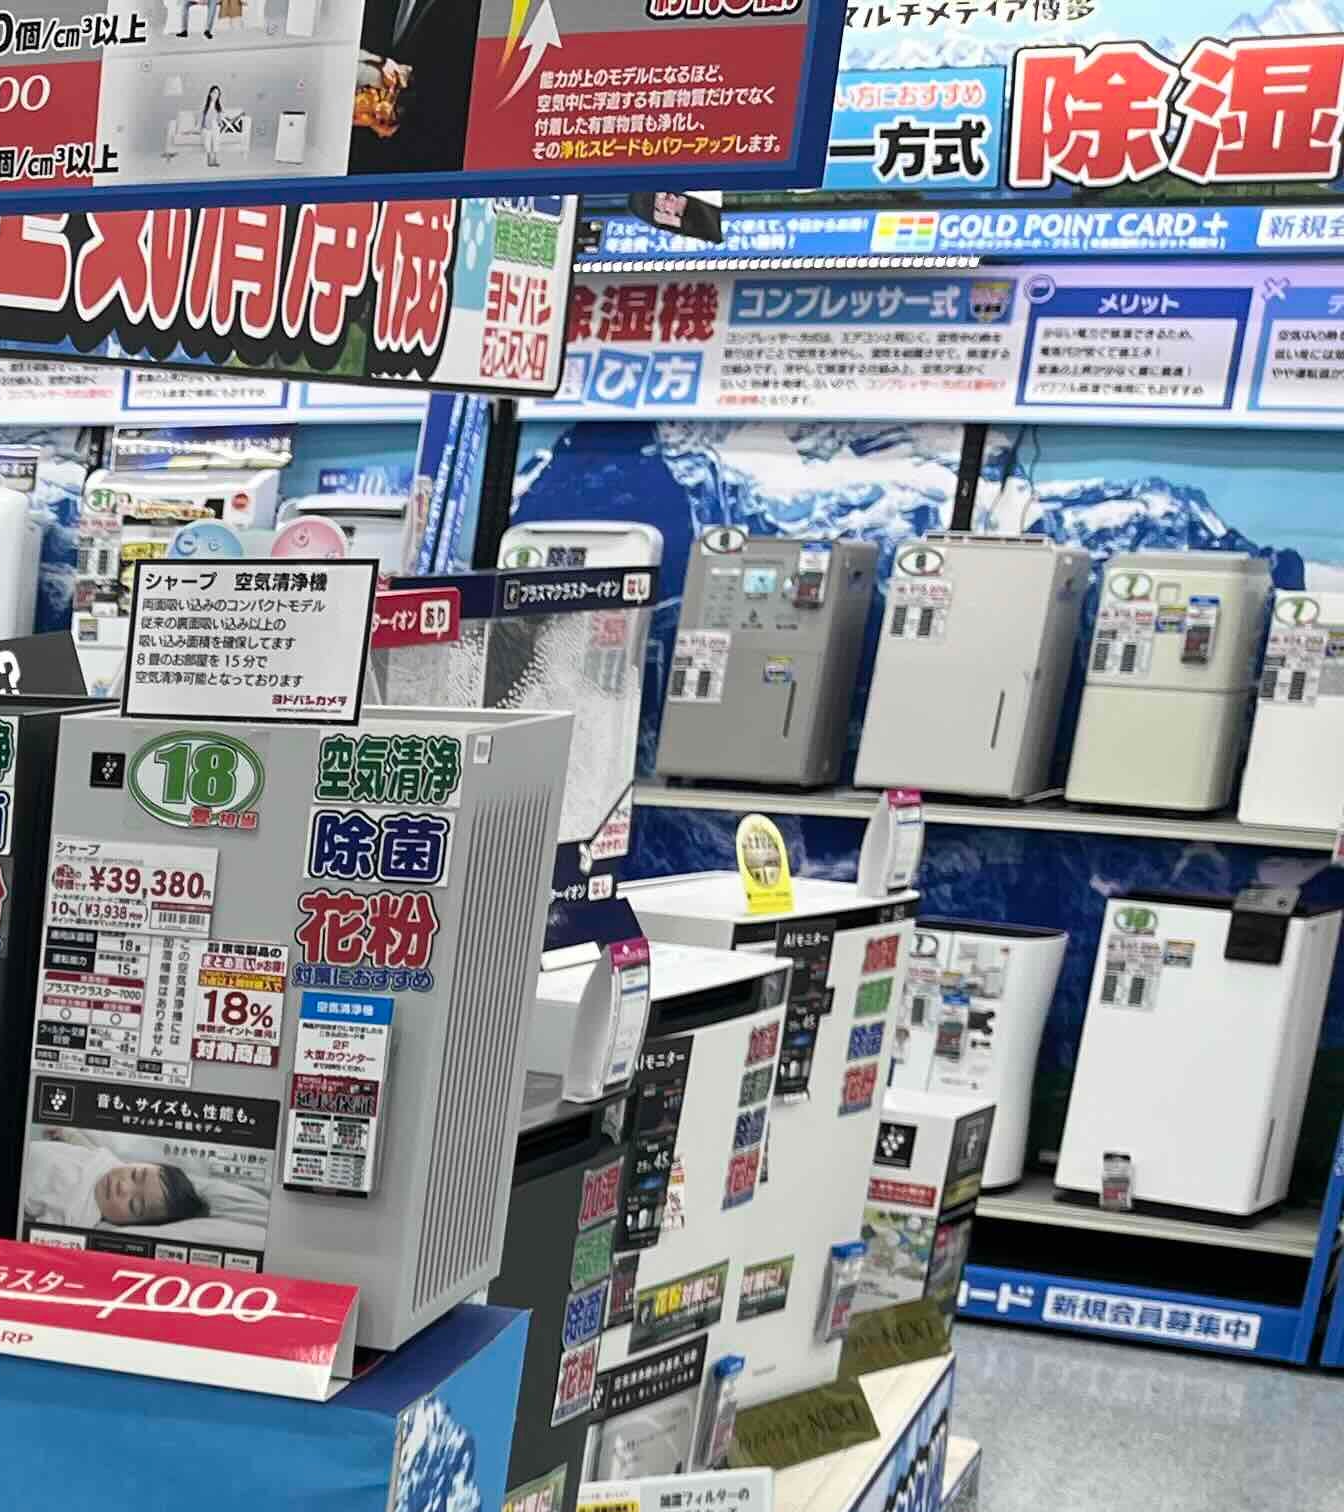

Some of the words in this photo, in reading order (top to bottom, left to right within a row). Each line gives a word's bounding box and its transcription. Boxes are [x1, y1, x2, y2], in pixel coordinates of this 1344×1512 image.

[540, 66, 725, 90] 能力が上のモデルになるほど、
[537, 87, 775, 113] 空気中に浮遊する有害物質だけでなく
[1015, 40, 1344, 188] 除湿
[535, 113, 706, 136] 付着した有害物質も浄化し、
[532, 134, 780, 159] その浄化スピードもパワーアップします。
[939, 214, 1021, 237] GOLD
[1026, 213, 1110, 237] POINT
[1118, 212, 1196, 236] CARD
[487, 270, 550, 325] ヨドバシ
[737, 287, 960, 320] コンプレッサー式
[1097, 293, 1180, 315] メリット
[144, 573, 217, 592] シャープ
[234, 571, 328, 592] 空気清浄機
[142, 597, 326, 614] 両面吸い込みのコンパクトモデル
[138, 634, 296, 651] 吸い込み面積を確保してます
[135, 671, 304, 689] 空気清浄可能となっております
[153, 742, 239, 806] 18
[315, 735, 463, 805] 空気清浄
[56, 841, 101, 856] シャープ
[311, 811, 446, 882] 除菌
[296, 889, 440, 969] 花粉
[292, 963, 434, 993] 対策におすすめ
[202, 989, 274, 1029] 18%
[97, 1091, 258, 1125] 音も、サイズも、性能も。
[99, 1268, 278, 1323] 7000
[1051, 1292, 1253, 1343] 新規会員募集中
